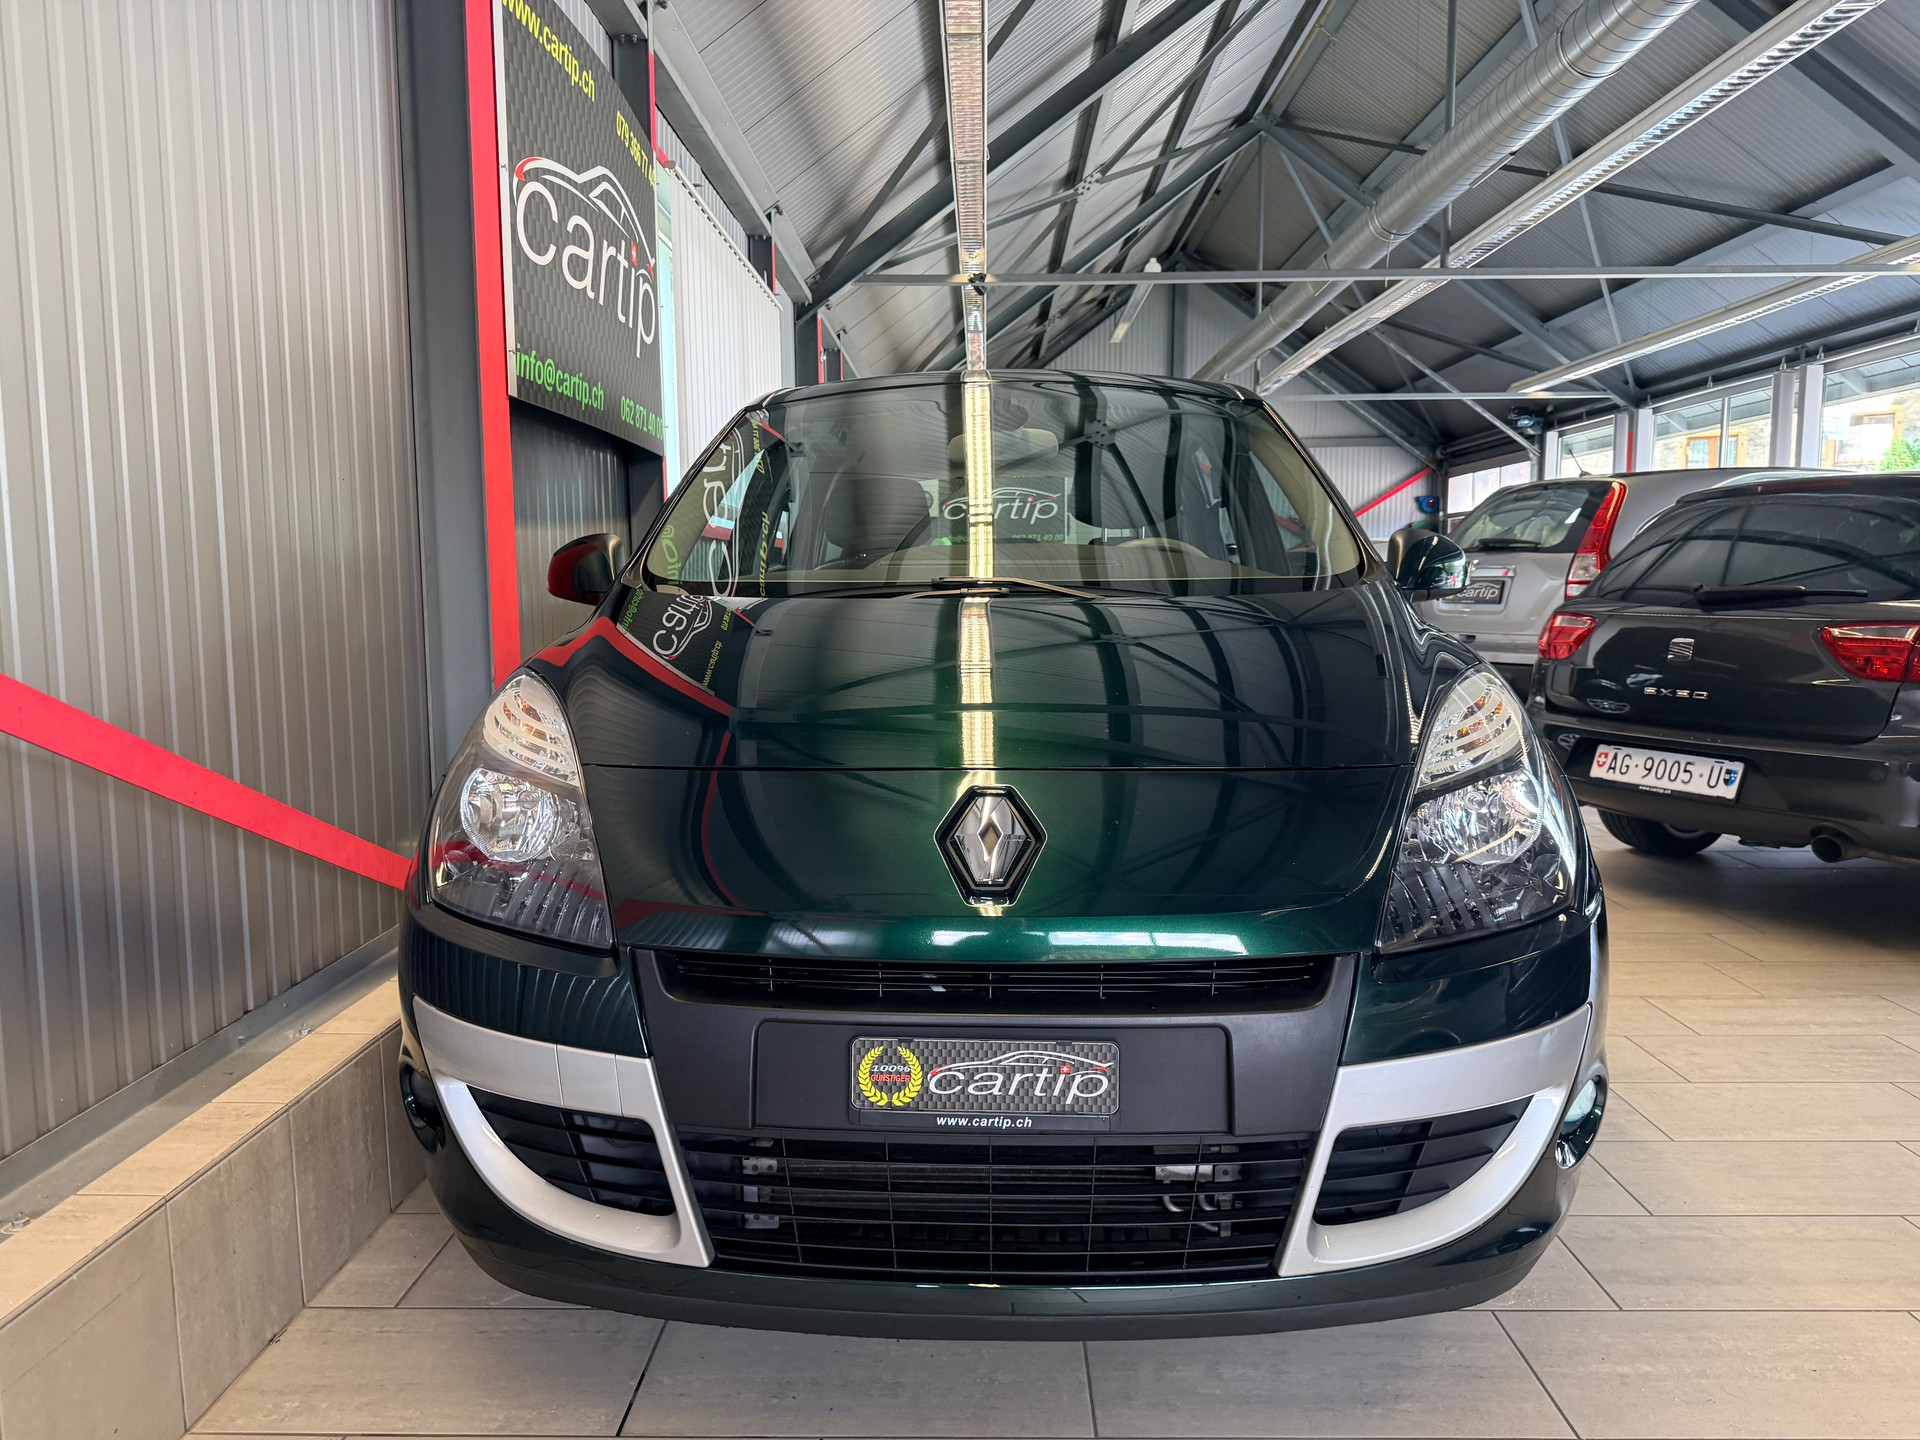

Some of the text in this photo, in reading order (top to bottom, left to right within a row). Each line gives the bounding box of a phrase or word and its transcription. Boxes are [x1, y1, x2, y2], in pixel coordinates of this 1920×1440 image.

[616, 110, 629, 148] 079
[641, 149, 648, 179] 77
[517, 180, 656, 358] cartip
[516, 343, 604, 411] info@cartip.ch
[620, 395, 635, 425] 062
[635, 404, 647, 433] 871
[648, 412, 656, 437] 40
[943, 496, 1058, 525] crtip
[1643, 686, 1709, 700] EXEO
[928, 1065, 1109, 1104] cartip
[936, 1115, 1032, 1130] www.cartip.ch
